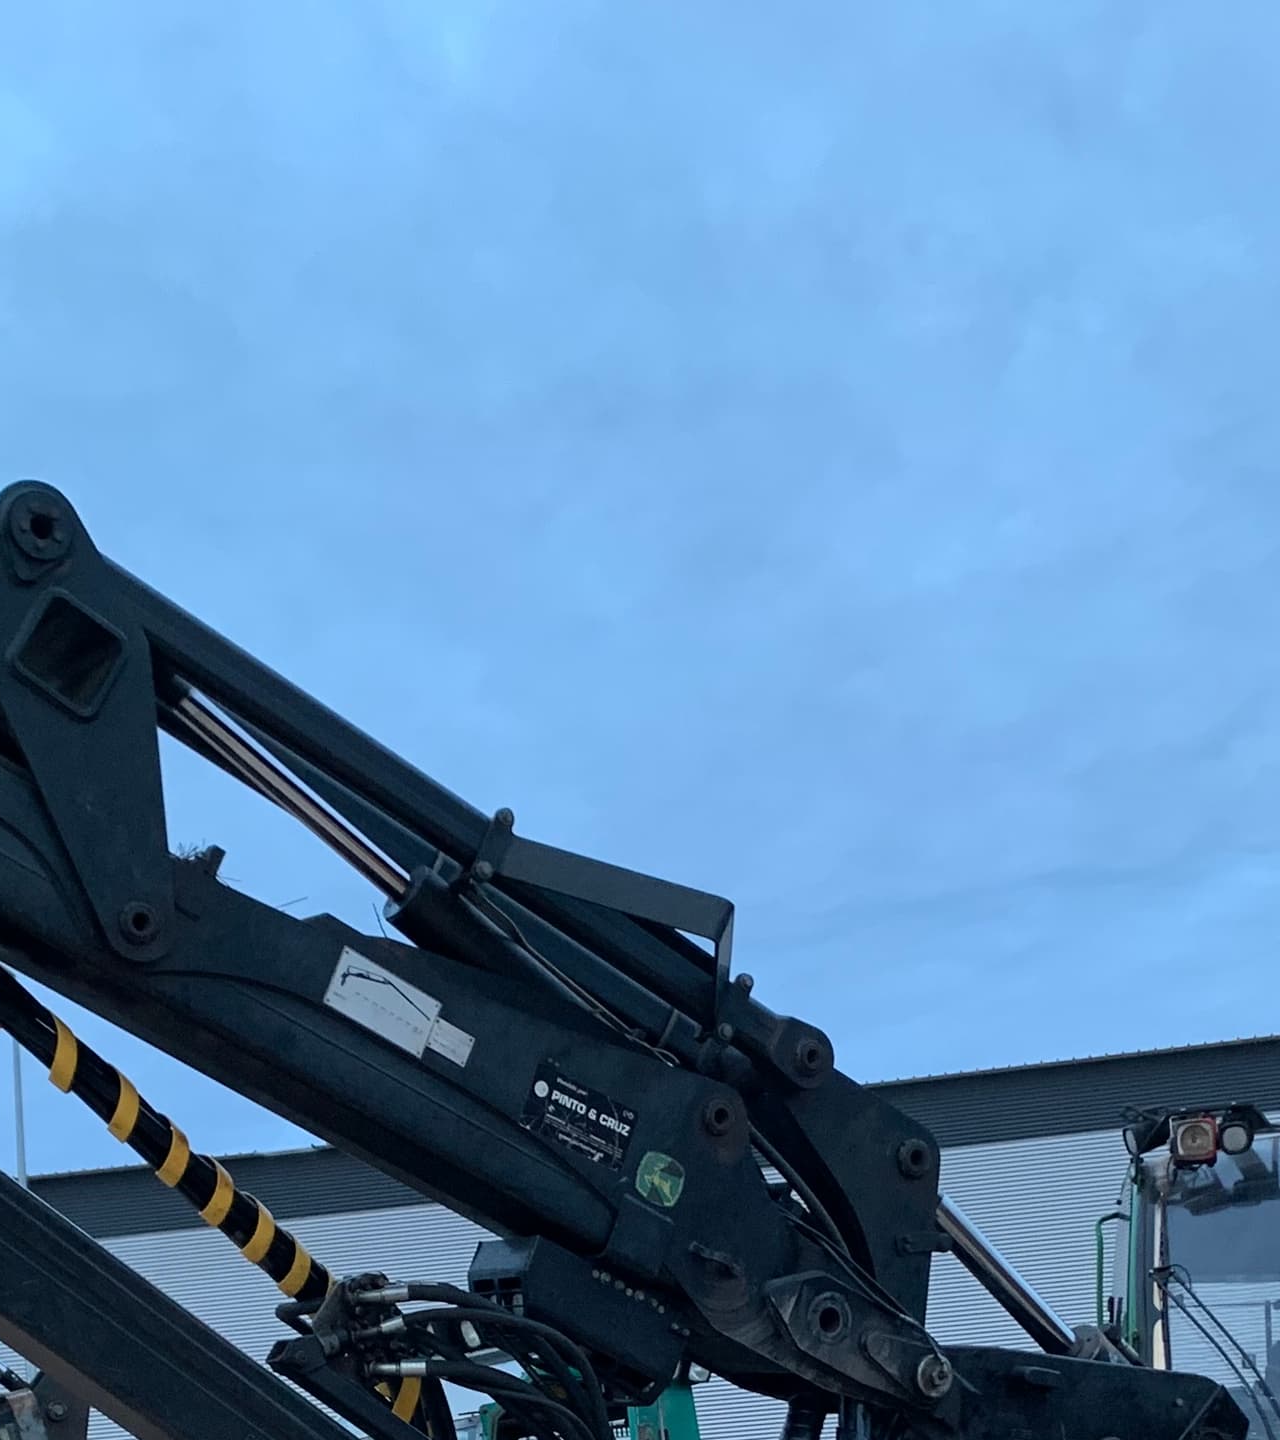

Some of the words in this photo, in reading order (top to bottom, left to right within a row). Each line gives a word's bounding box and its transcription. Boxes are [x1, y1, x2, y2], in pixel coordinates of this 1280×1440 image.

[551, 1090, 587, 1115] PINTO
[587, 1108, 598, 1121] &
[599, 1114, 631, 1137] CRUZ
